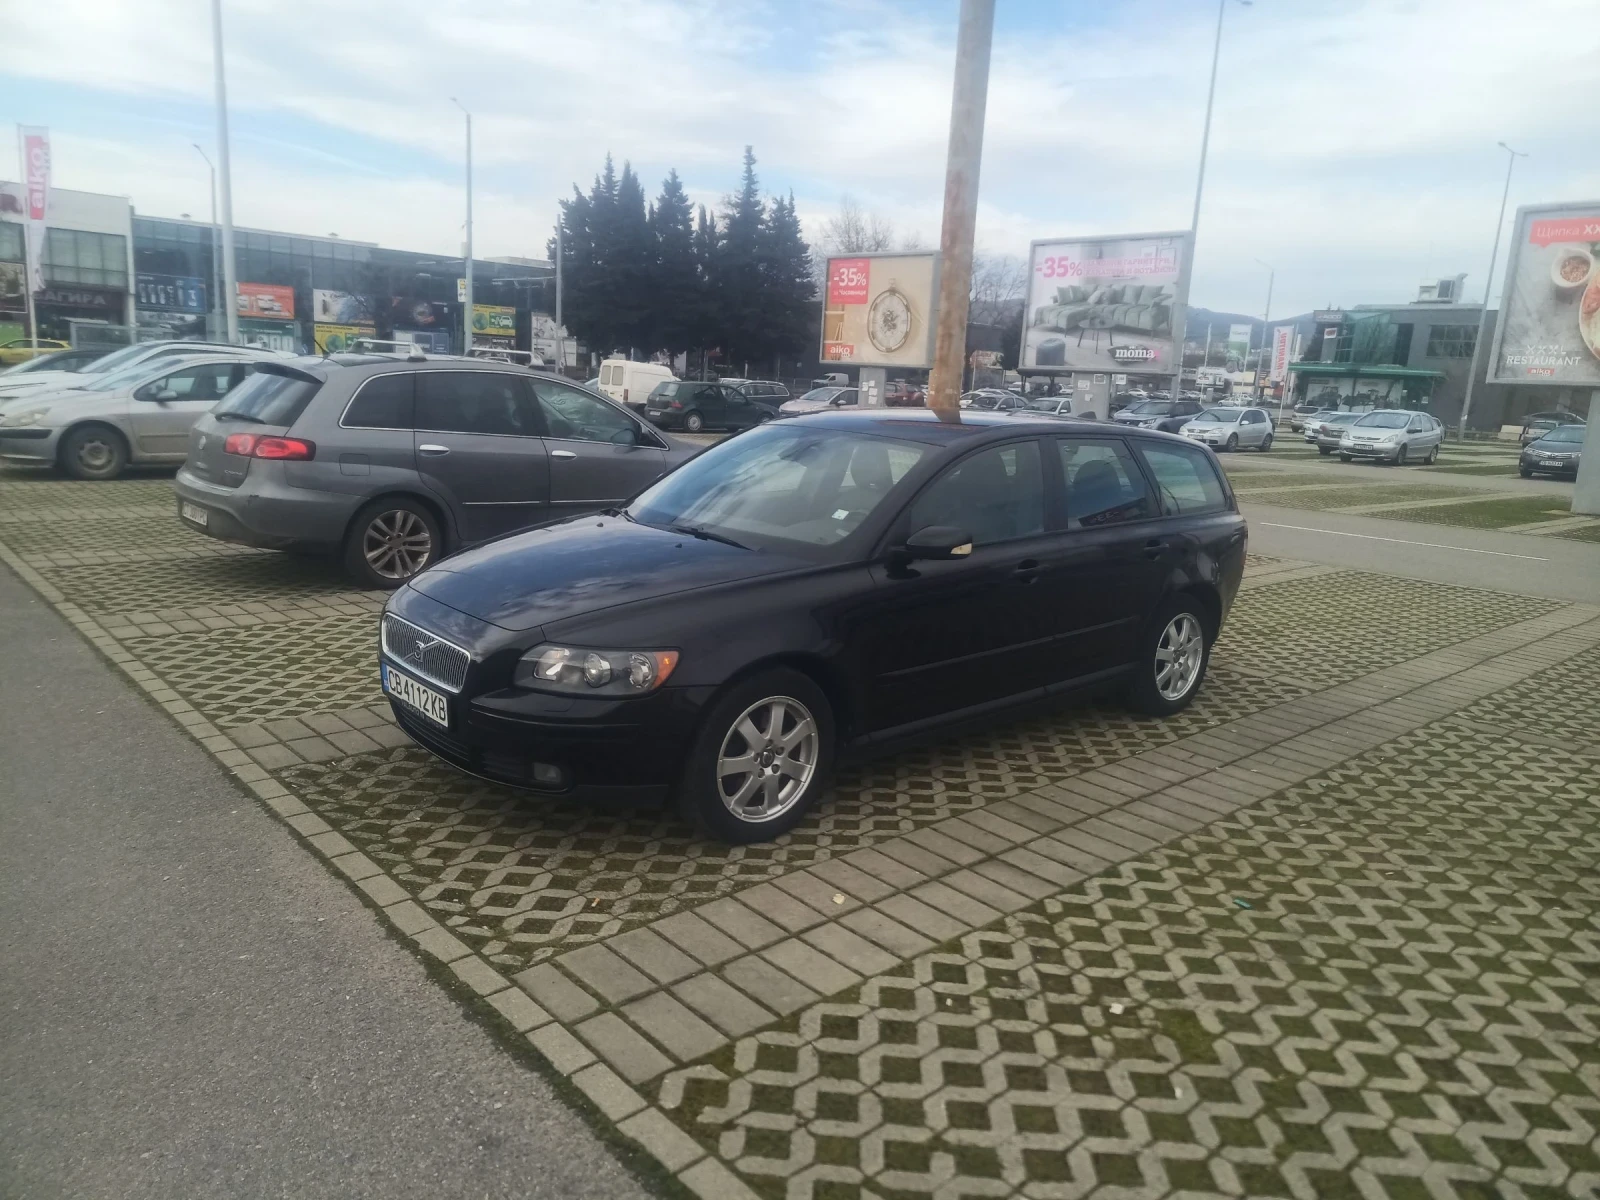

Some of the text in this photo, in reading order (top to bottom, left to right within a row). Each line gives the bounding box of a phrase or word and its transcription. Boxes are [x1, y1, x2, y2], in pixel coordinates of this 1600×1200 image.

[1536, 225, 1580, 237] Щипка
[1035, 256, 1083, 278] -35%
[833, 267, 867, 286] -35%
[830, 345, 851, 355] aiko
[1506, 355, 1581, 366] RESTAURANT
[388, 669, 447, 722] CB4112KB
